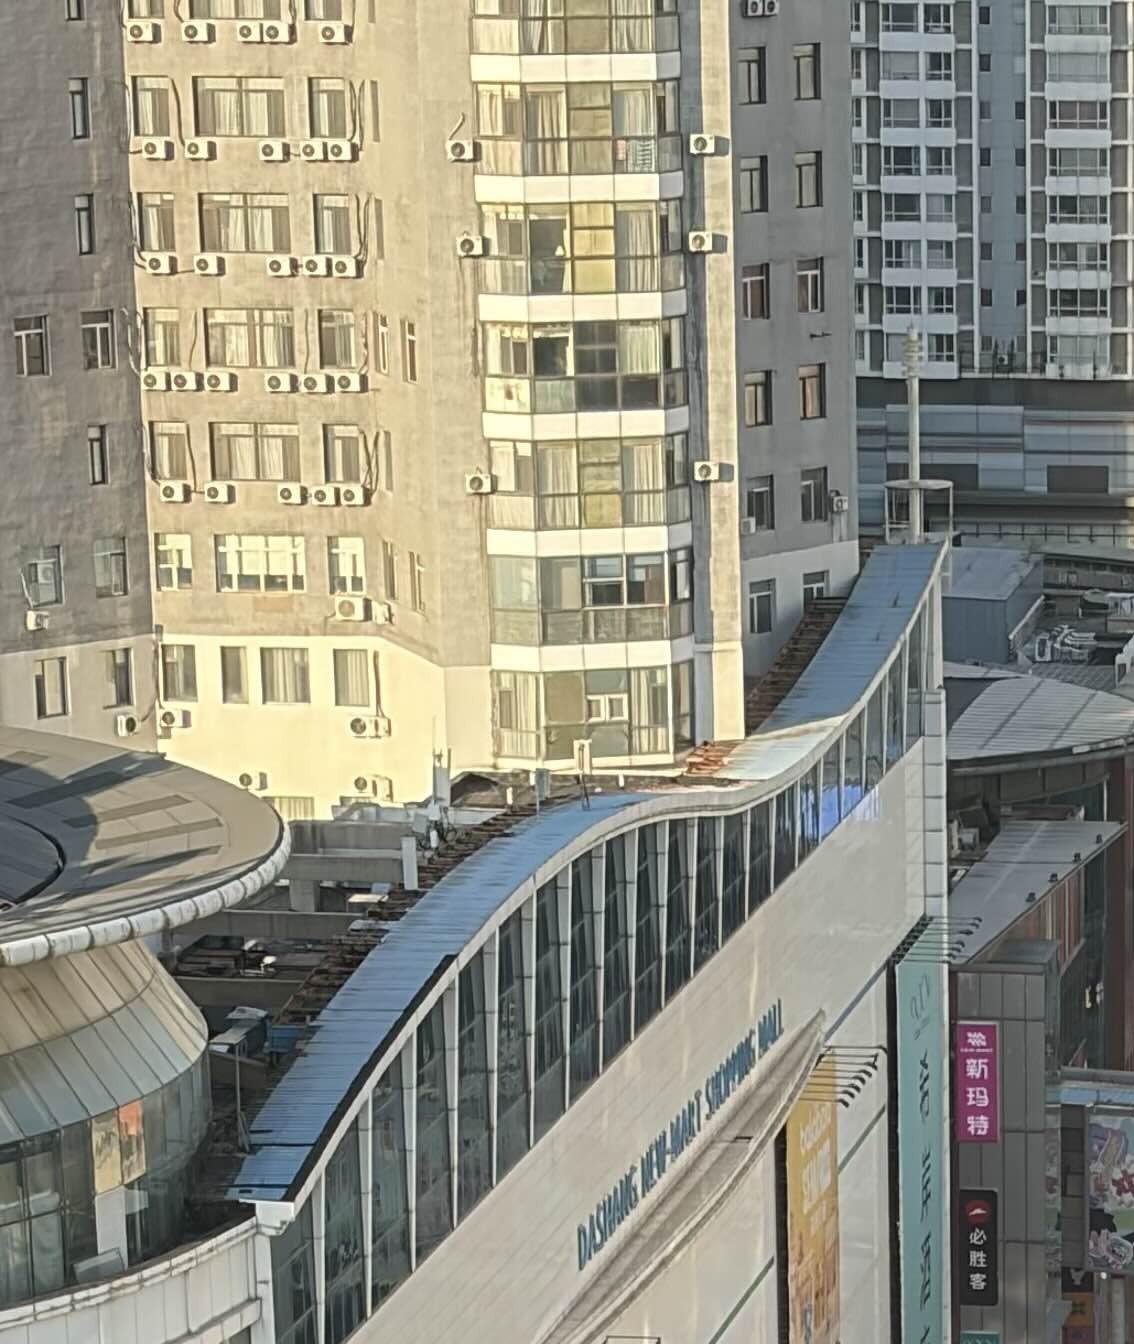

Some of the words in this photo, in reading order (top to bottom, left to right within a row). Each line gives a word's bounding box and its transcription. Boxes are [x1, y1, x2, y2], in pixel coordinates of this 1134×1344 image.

[965, 1058, 989, 1136] 新玛特
[968, 1227, 988, 1291] 必胜客
